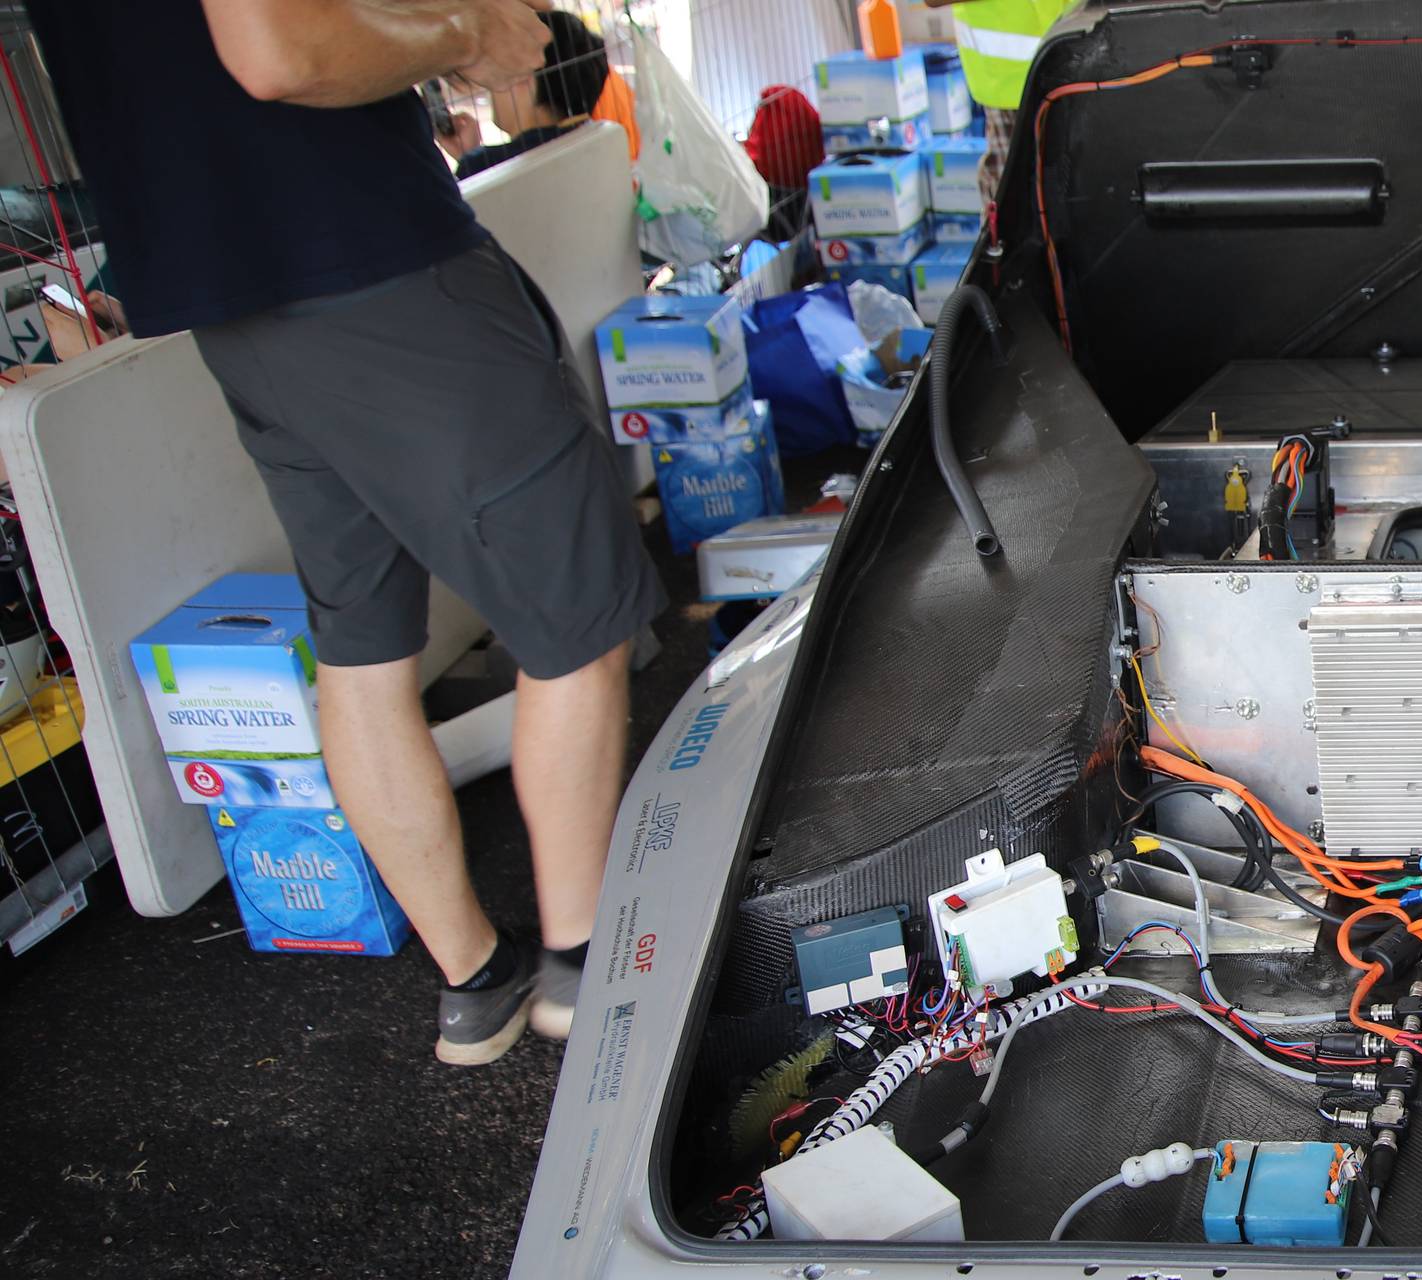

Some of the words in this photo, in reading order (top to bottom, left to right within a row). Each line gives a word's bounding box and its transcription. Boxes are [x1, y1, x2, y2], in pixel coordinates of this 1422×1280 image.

[616, 373, 660, 385] SPRING
[661, 372, 705, 384] WATER
[682, 474, 746, 497] Marble
[703, 496, 735, 518] Hill
[168, 708, 229, 727] SPRING
[229, 709, 296, 727] WATER
[210, 699, 273, 709] AUSTRALIAN
[669, 702, 731, 771] WAECO
[639, 798, 653, 821] Laser
[645, 801, 681, 852] LPKF
[626, 827, 645, 873] Electronics
[250, 850, 338, 880] Marble
[280, 882, 326, 911] Hill
[626, 896, 641, 938] Gesellschaft
[611, 917, 625, 956] Hochschule
[633, 933, 656, 974] GDF
[606, 956, 619, 985] Bochum
[620, 1019, 632, 1050] ERNST
[598, 1073, 611, 1101] GmbH
[608, 1050, 626, 1099] WAGENER
